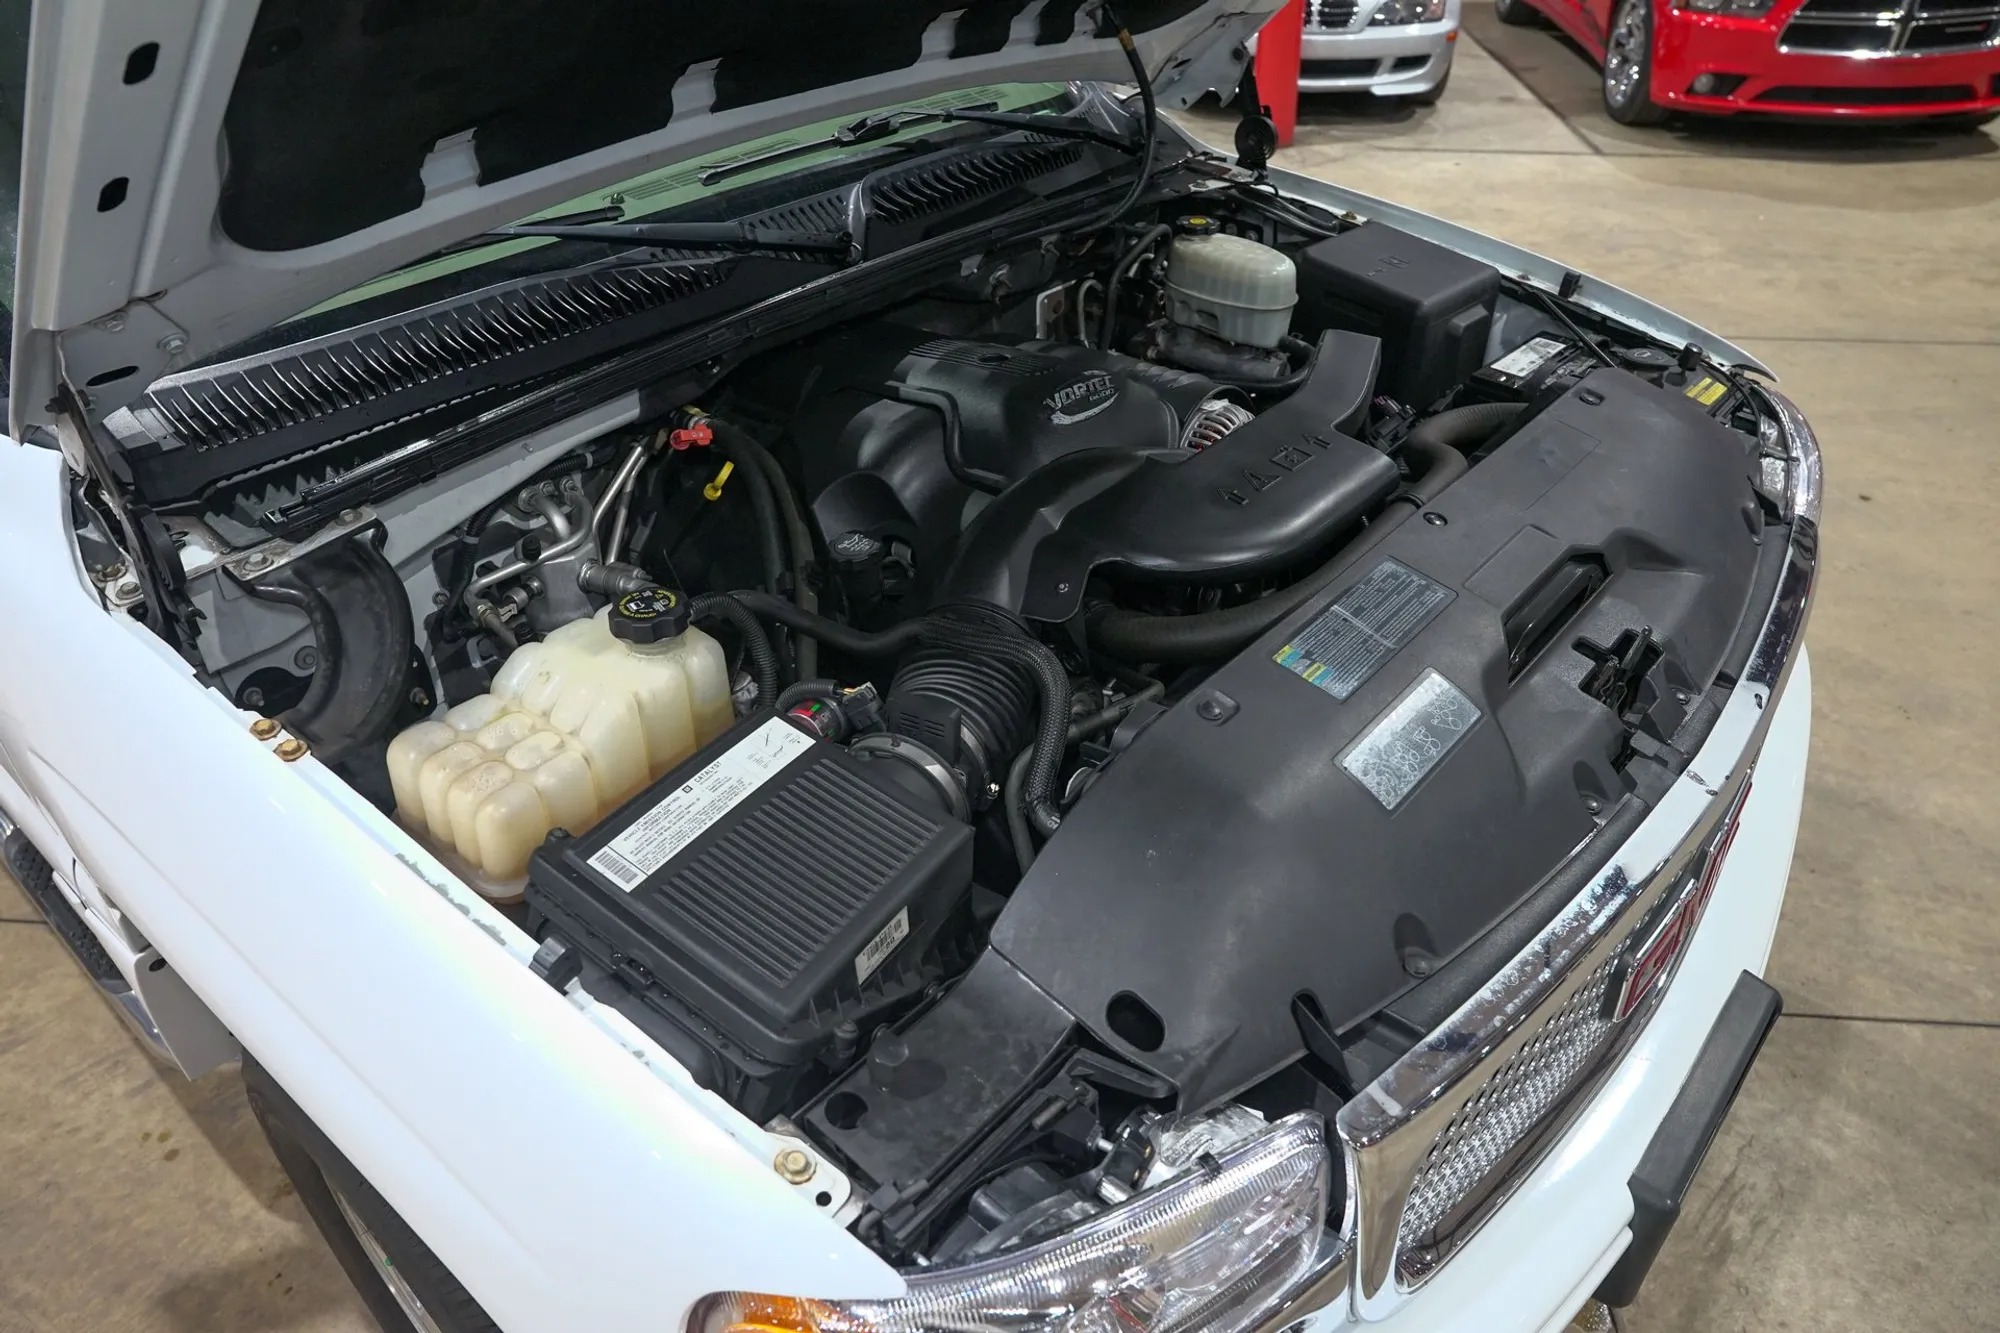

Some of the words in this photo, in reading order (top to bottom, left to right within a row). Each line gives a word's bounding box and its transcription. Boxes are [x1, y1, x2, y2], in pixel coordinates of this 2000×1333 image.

[1043, 375, 1116, 410] VORTEC
[694, 760, 722, 783] CATALYST
[641, 810, 663, 828] EMISSION
